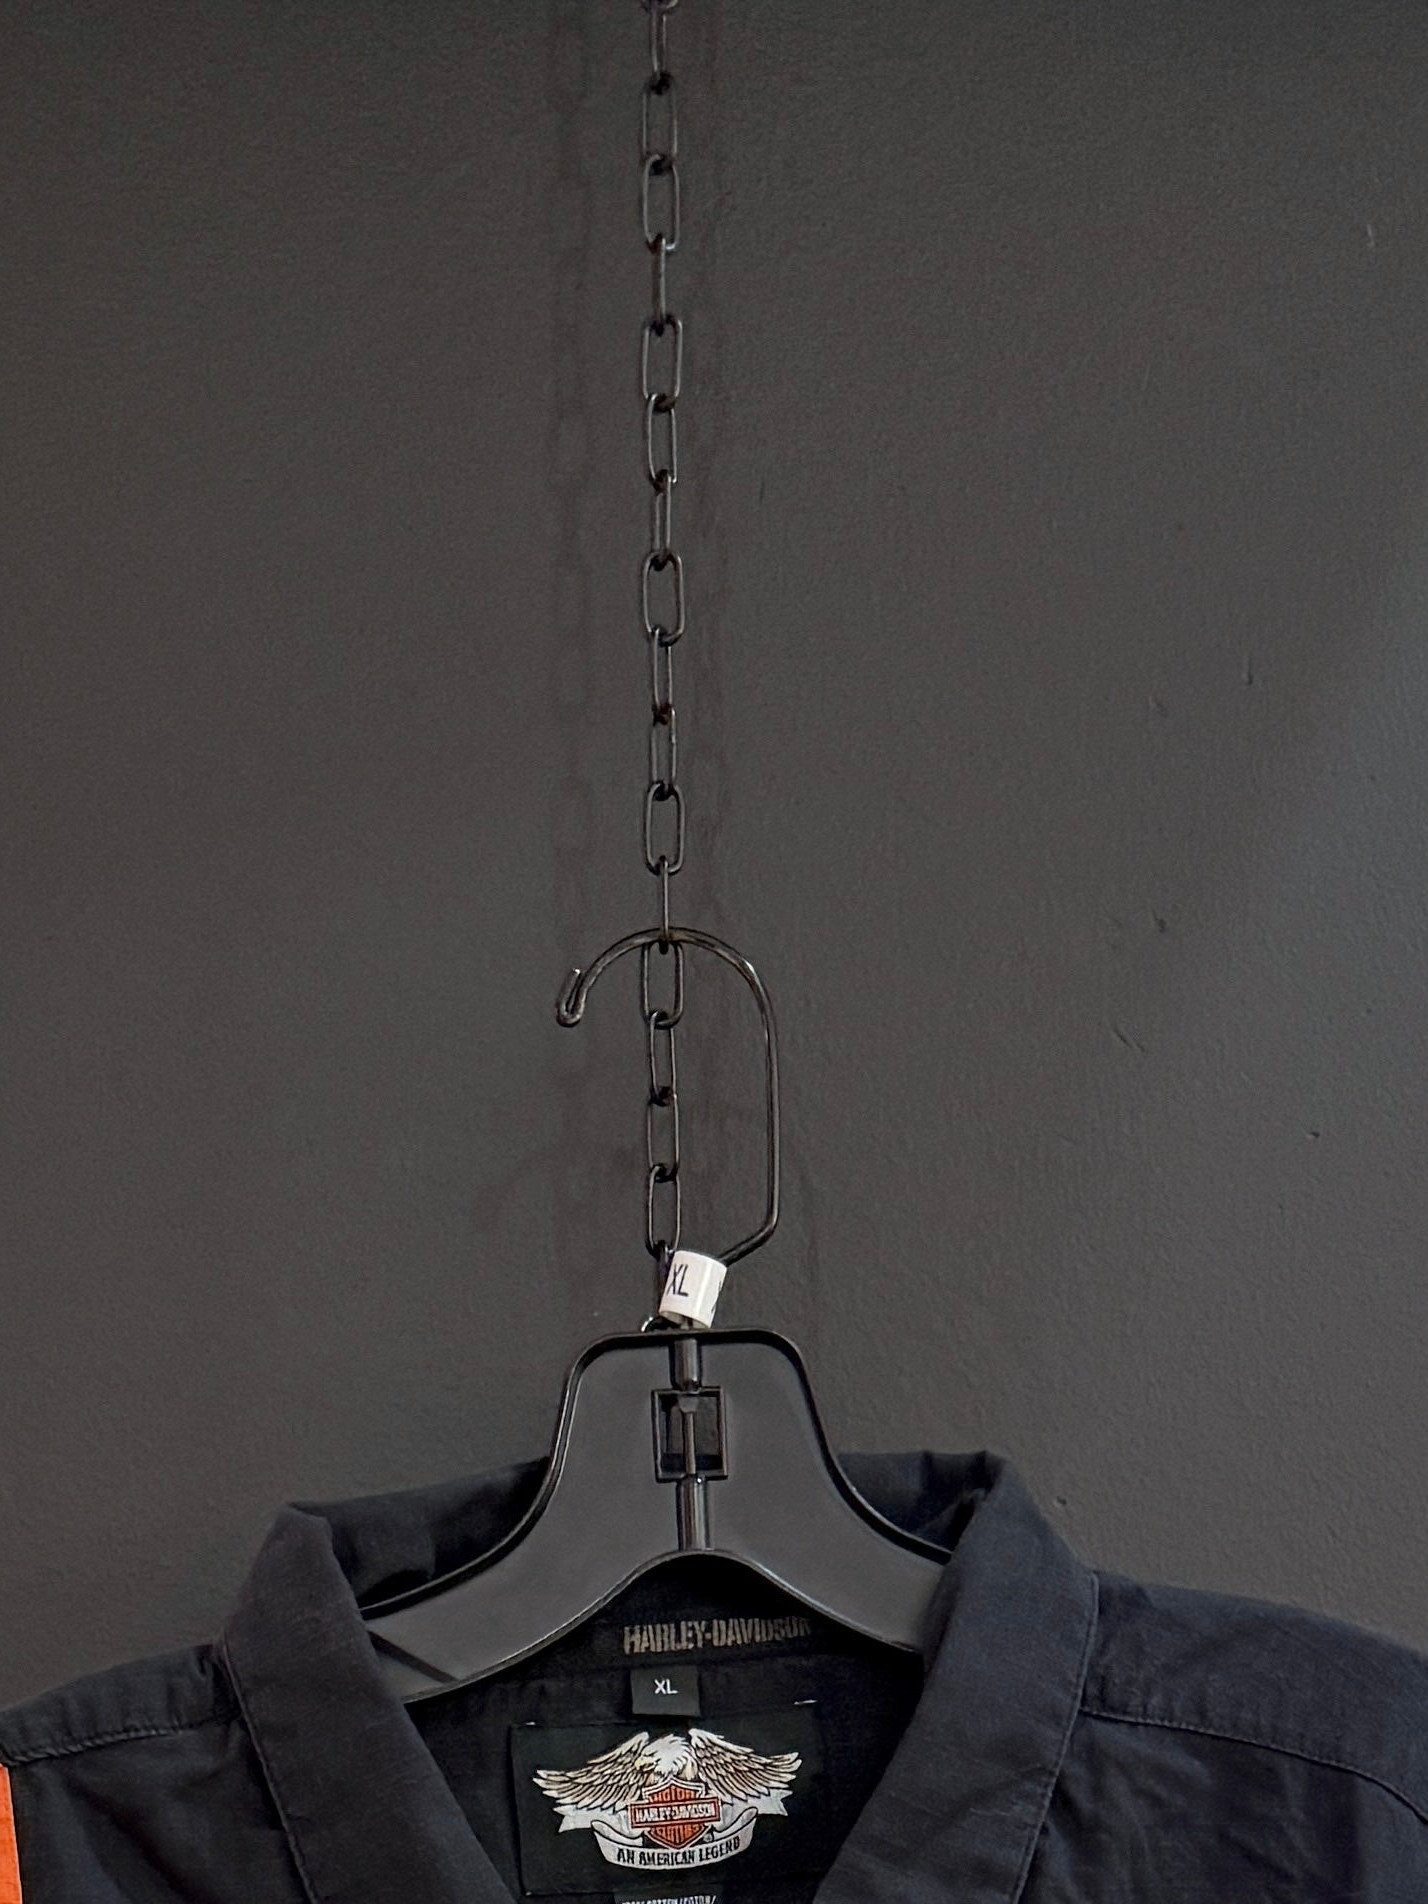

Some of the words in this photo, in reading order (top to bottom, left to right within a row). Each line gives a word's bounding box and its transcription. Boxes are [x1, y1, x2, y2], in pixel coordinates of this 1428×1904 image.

[665, 1263, 690, 1298] XL
[623, 1614, 812, 1655] HARLEY-DAVIDSON
[653, 1678, 679, 1695] XL
[616, 1848, 635, 1864] AN
[638, 1849, 695, 1867] AMERICAN
[698, 1835, 741, 1862] LEGEND
